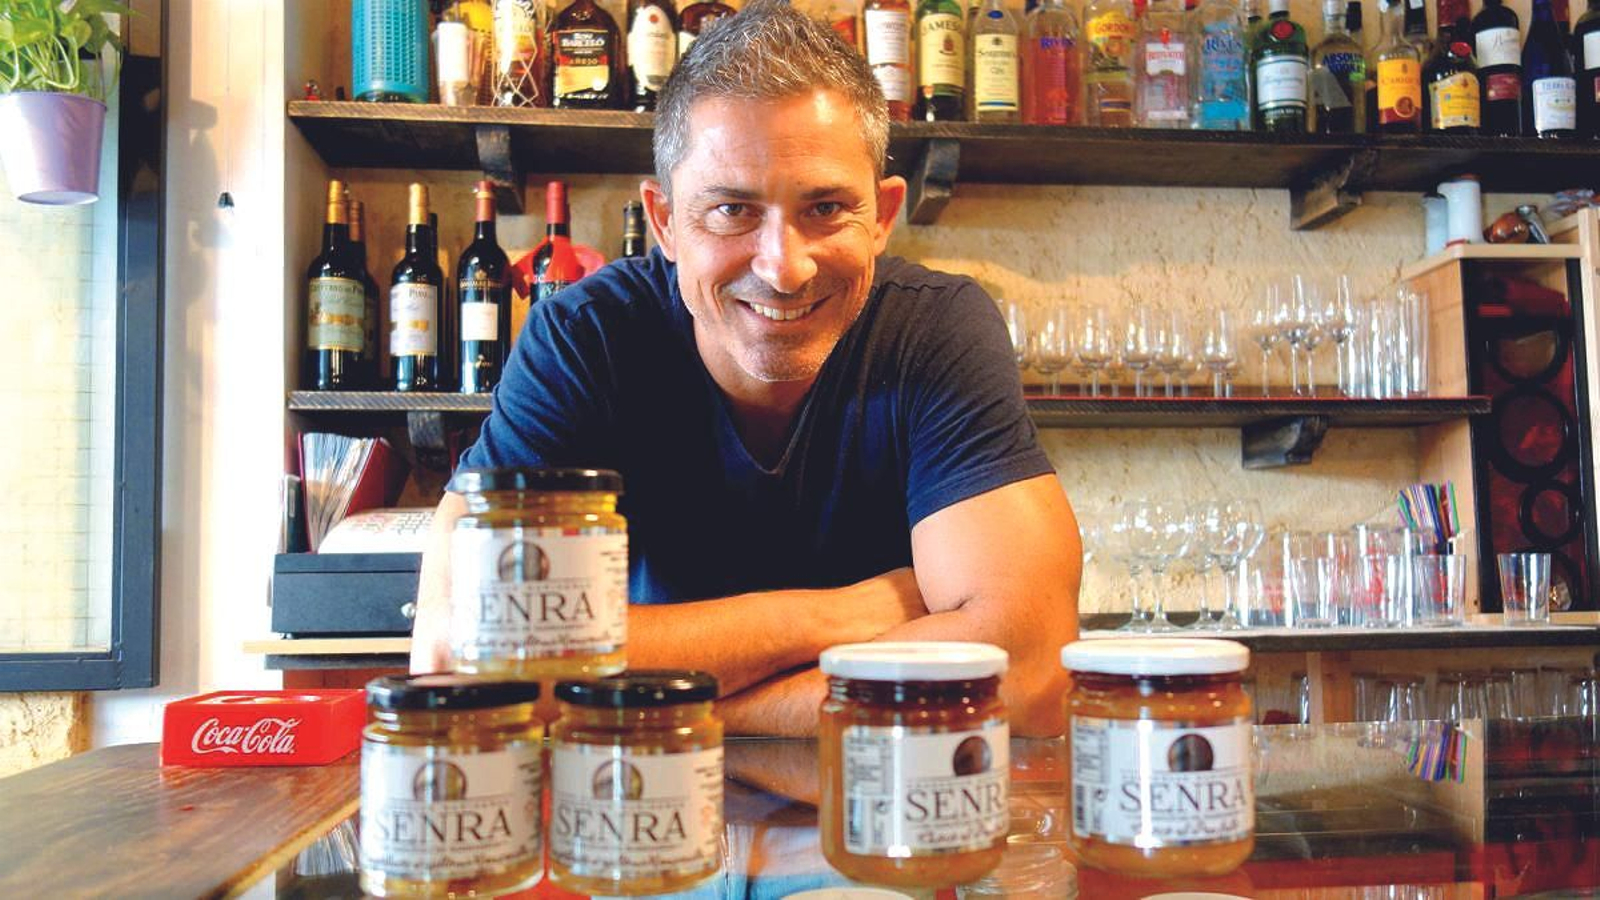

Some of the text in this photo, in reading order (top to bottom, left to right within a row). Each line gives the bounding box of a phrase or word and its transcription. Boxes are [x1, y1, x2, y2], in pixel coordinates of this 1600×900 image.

[478, 591, 596, 624] ENRA
[191, 717, 302, 755] Coca-Cola
[1119, 778, 1247, 814] SENRA
[374, 808, 512, 845] SENRA
[556, 803, 688, 843] SENRA
